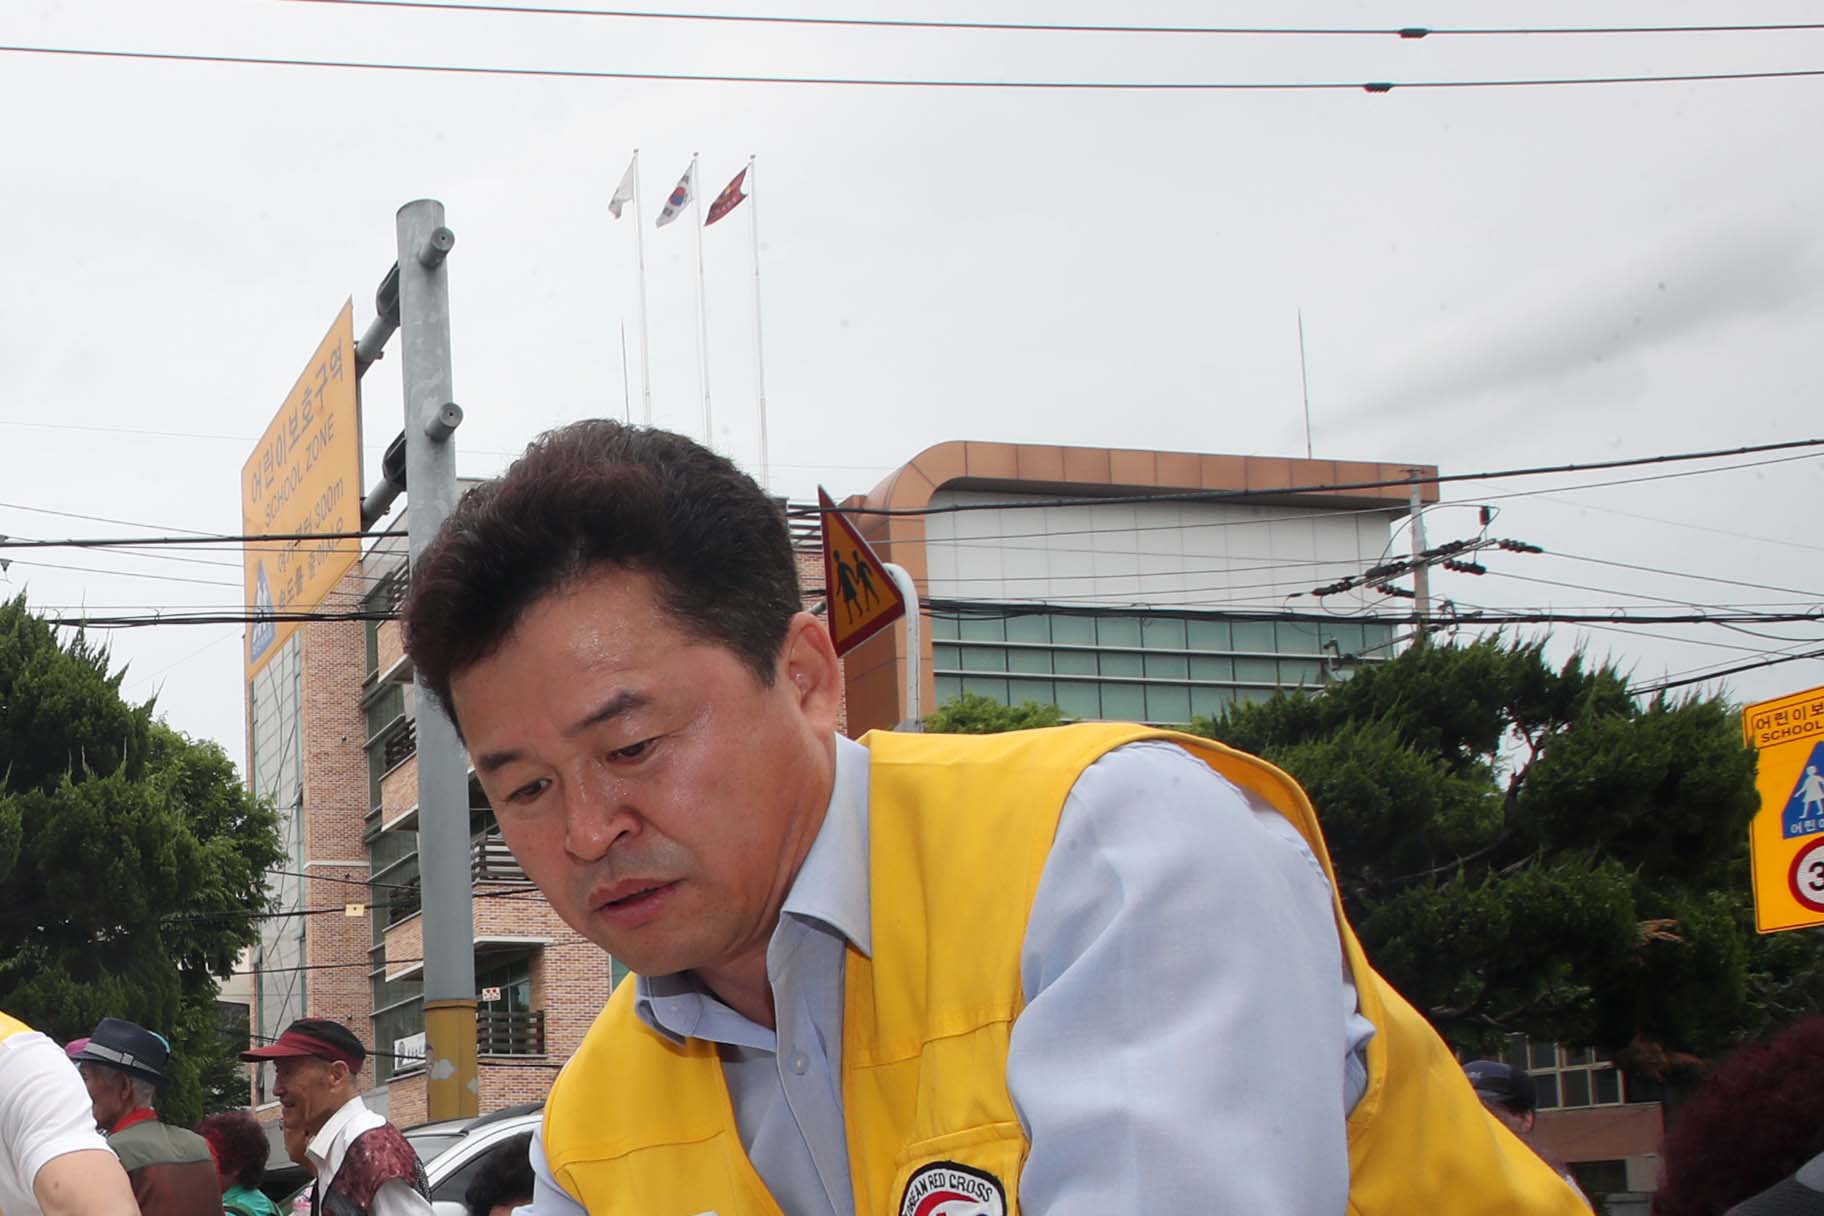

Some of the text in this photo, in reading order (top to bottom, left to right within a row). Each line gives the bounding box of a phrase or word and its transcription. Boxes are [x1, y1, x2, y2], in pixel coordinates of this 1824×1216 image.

[251, 336, 344, 505] 어린이보호구역
[265, 412, 335, 528] SCHOOL ZONE
[1761, 720, 1823, 743] SCHOOL
[928, 1172, 946, 1190] RED
[949, 1173, 993, 1203] CROSS
